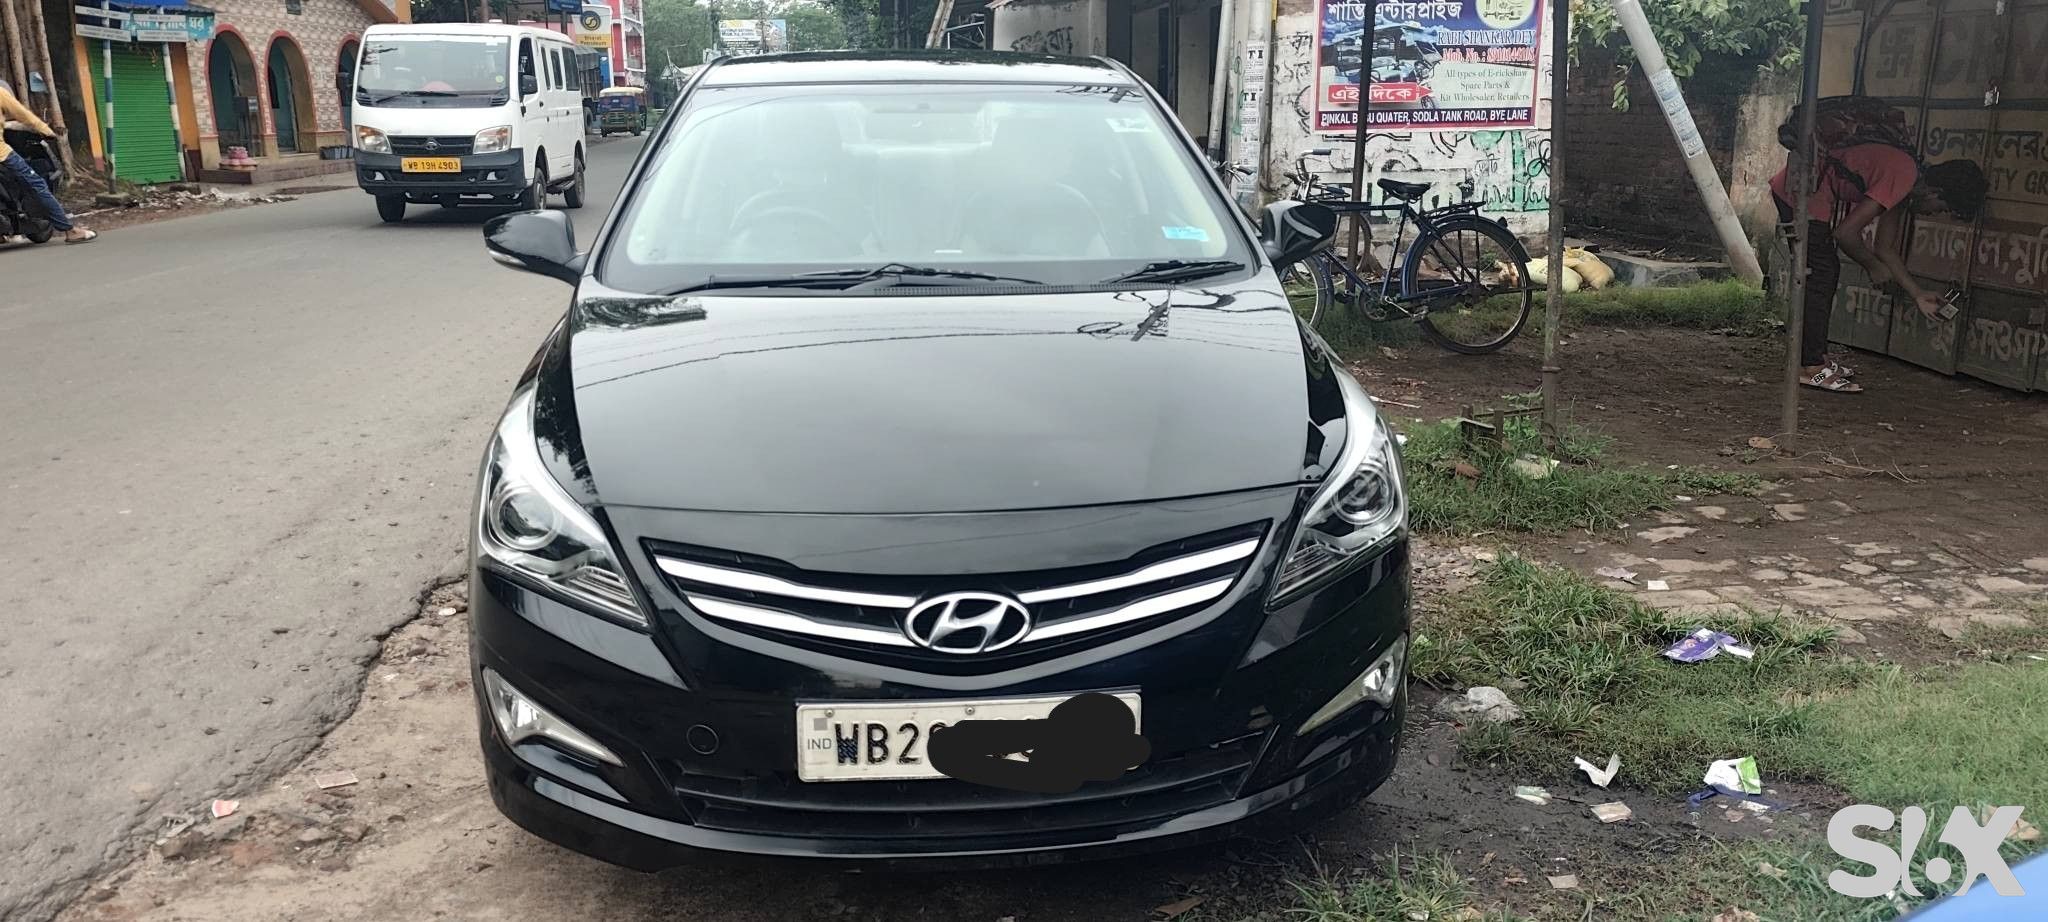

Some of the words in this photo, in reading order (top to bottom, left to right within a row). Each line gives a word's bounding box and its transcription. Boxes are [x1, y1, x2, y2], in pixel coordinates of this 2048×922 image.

[1437, 30, 1463, 45] RABI
[1464, 30, 1513, 46] SHANKAR
[1513, 29, 1536, 45] DEY
[1445, 69, 1456, 78] All
[1456, 70, 1476, 80] types
[1477, 68, 1486, 78] of
[1488, 68, 1528, 78] E-rickshaw
[1460, 80, 1482, 91] Spare
[1484, 80, 1502, 89] Parts
[1504, 80, 1510, 89] &
[1332, 86, 1360, 101] এই
[1369, 84, 1413, 100] দিকে
[1440, 93, 1451, 102] Kit
[1376, 111, 1411, 124] QUATER,
[1412, 110, 1440, 122] SODLA
[1441, 110, 1463, 122] TANK
[1463, 109, 1488, 122] ROAD,
[1490, 109, 1506, 121] BYE
[1507, 109, 1529, 120] LANE
[807, 738, 832, 750] IND
